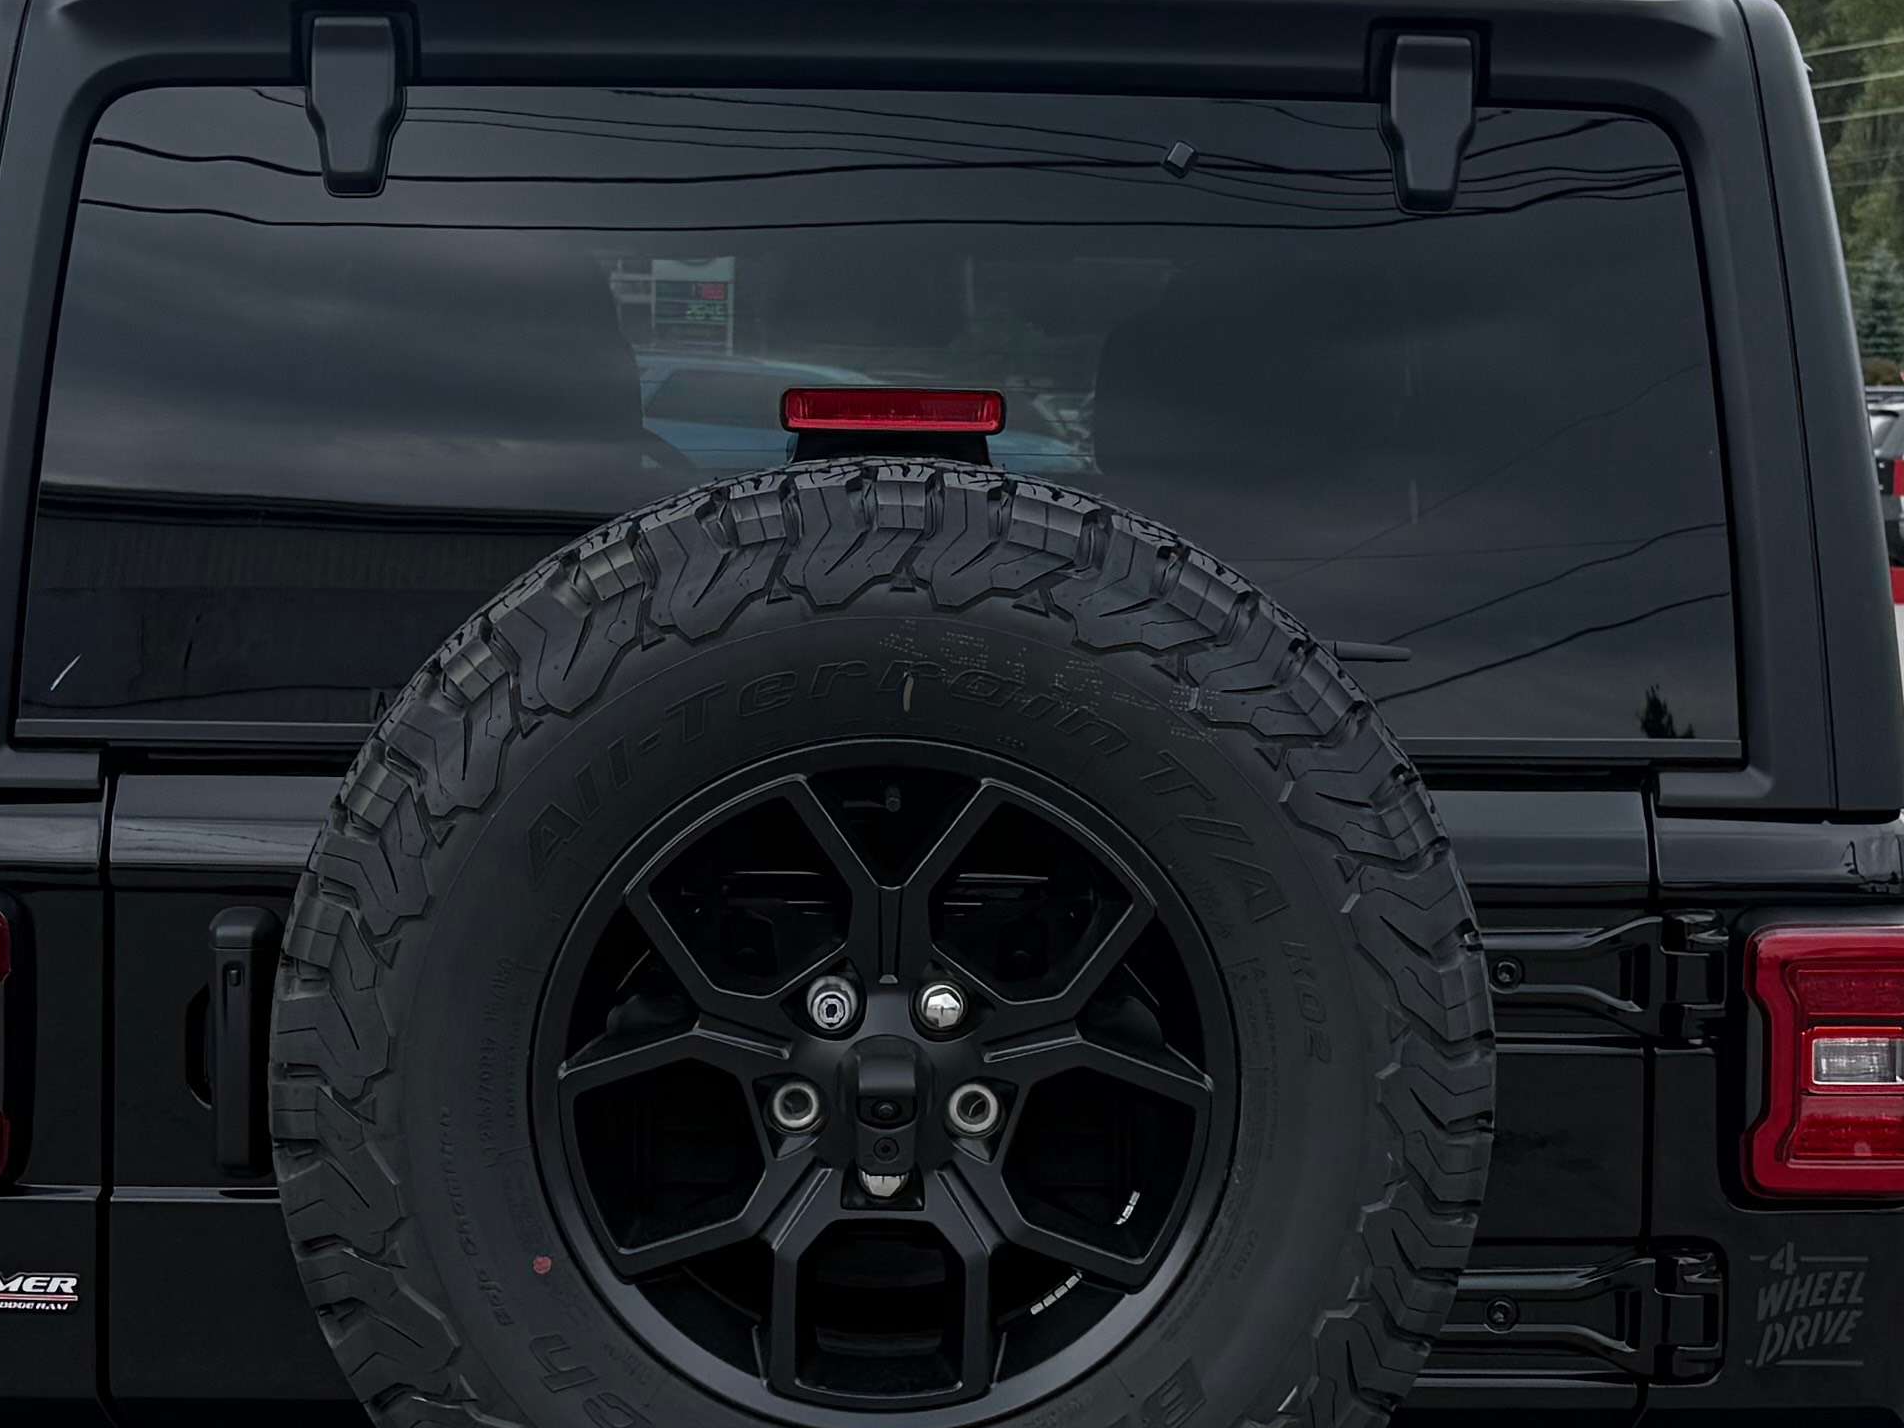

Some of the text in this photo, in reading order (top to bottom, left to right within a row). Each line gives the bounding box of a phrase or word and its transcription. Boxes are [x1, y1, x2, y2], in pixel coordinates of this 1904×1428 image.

[1769, 1241, 1798, 1275] 4
[35, 1302, 69, 1311] RAM
[1757, 1271, 1866, 1323] WHEEL
[1756, 1309, 1864, 1369] DRIVE
